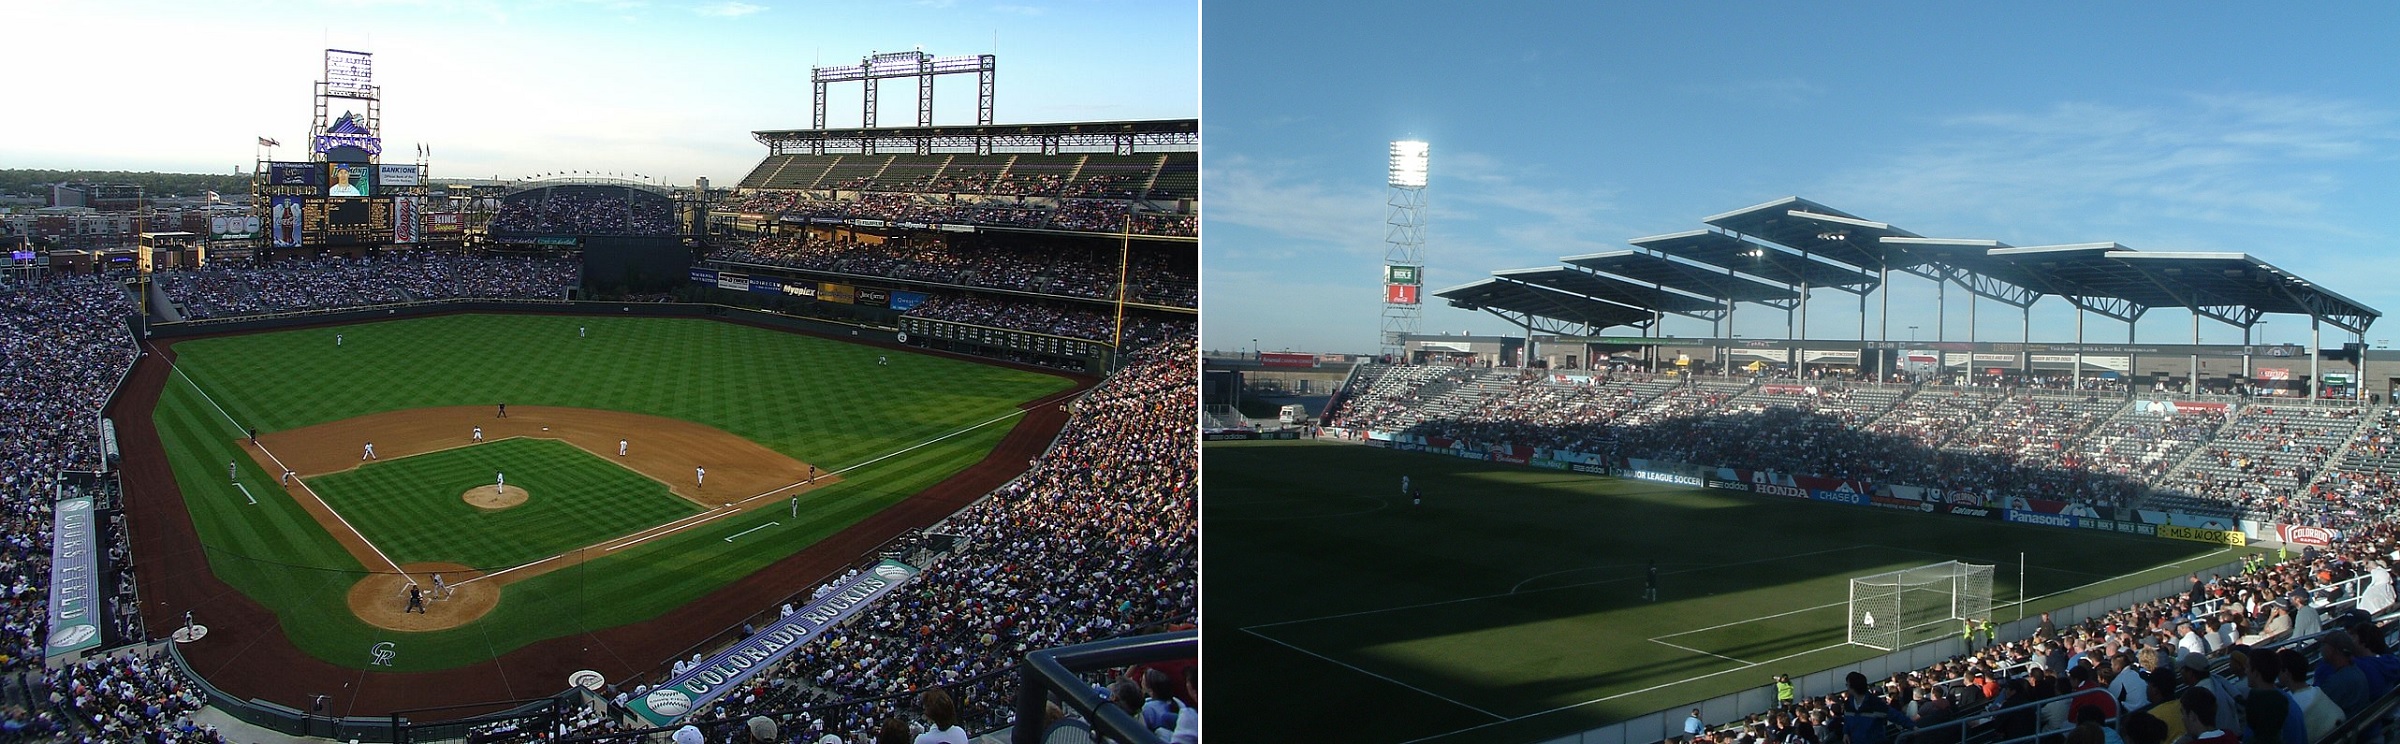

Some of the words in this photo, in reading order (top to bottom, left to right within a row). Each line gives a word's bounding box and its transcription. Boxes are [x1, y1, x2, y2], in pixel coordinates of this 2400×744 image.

[315, 135, 382, 155] ROCKIES
[381, 166, 400, 174] BANK
[397, 197, 410, 241] Coors
[434, 214, 457, 224] KING
[783, 284, 816, 297] Myoplex
[1585, 466, 1605, 475] adidas
[1623, 470, 1646, 479] MAJOR
[1647, 472, 1673, 483] LEAGUE
[1674, 475, 1701, 486] SOCCER
[1724, 482, 1749, 491] adidas
[1755, 483, 1810, 499] HONDA
[1819, 490, 1849, 502] CHASE
[1951, 506, 1989, 517] Gatorade
[2009, 509, 2071, 527] Panasonic
[2170, 528, 2191, 539] MLS
[2293, 527, 2328, 543] COLORADO
[683, 622, 807, 694] COLORADO
[802, 576, 886, 626] ROCKIES
